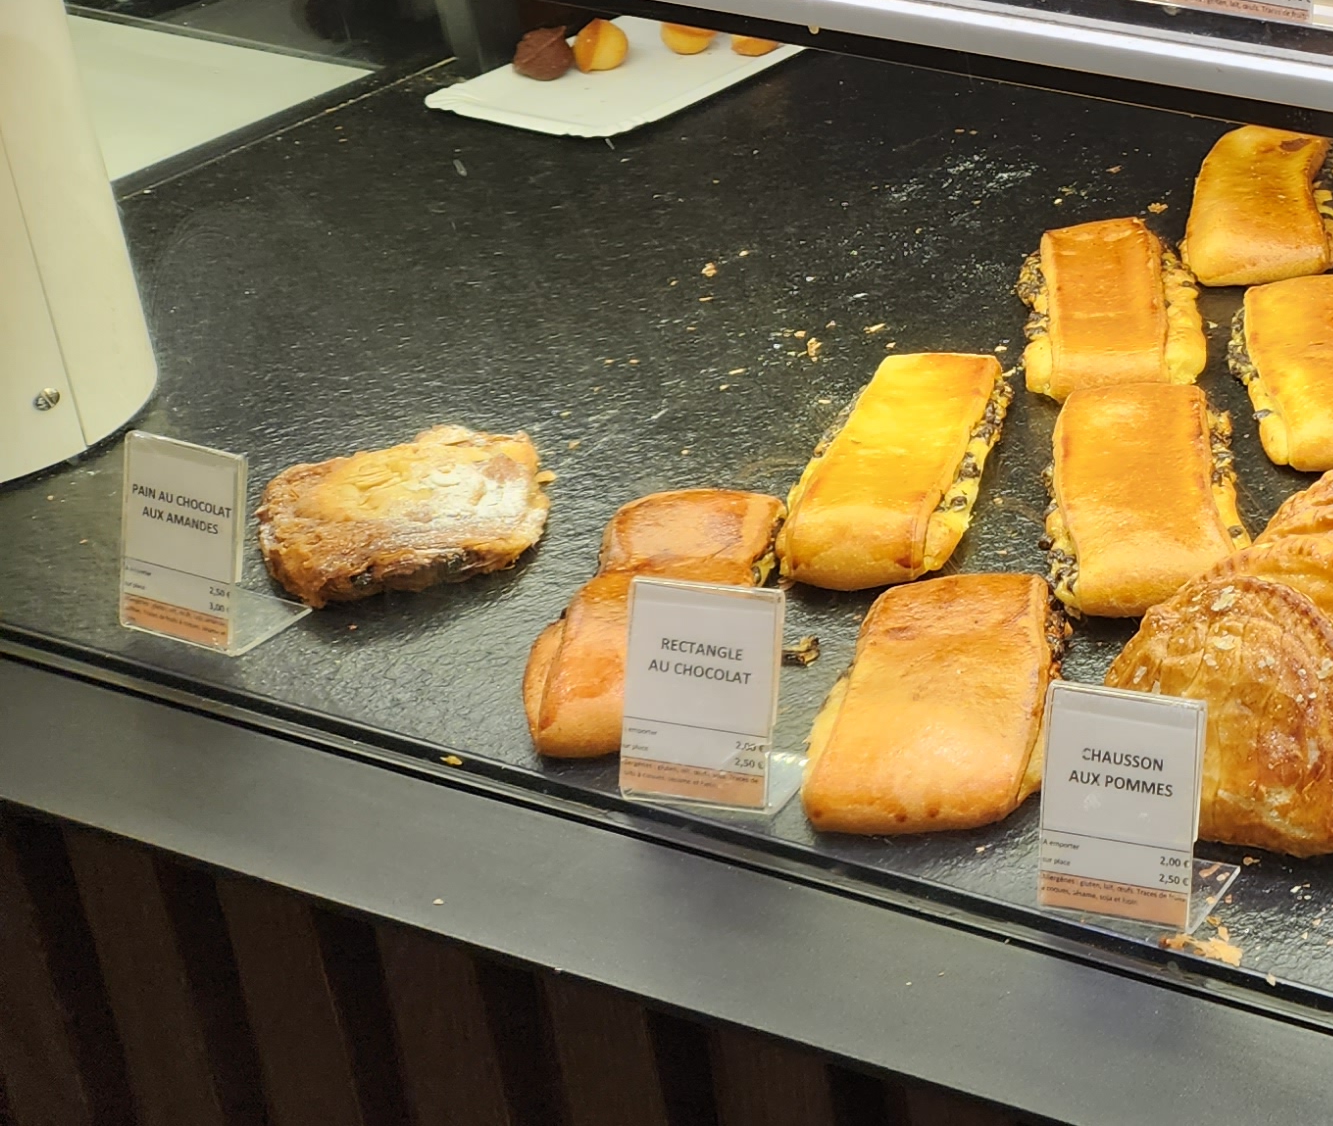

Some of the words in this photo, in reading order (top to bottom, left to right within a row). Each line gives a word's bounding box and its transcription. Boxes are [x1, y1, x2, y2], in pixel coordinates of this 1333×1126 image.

[132, 483, 156, 500] PAIN
[158, 490, 173, 504] AU
[176, 495, 232, 519] CHOCOLAT
[142, 506, 164, 521] AUX
[166, 512, 219, 535] AMANDES
[661, 637, 744, 661] RECTANGLE
[648, 659, 669, 673] AU
[674, 662, 751, 685] CHOCOLAT
[735, 757, 755, 768] 2,50
[1082, 747, 1164, 771] CHAUSSON
[1068, 770, 1100, 786] AUX
[1105, 775, 1173, 798] POMMES
[1160, 856, 1181, 868] 2,00
[1159, 873, 1180, 885] 2,50
